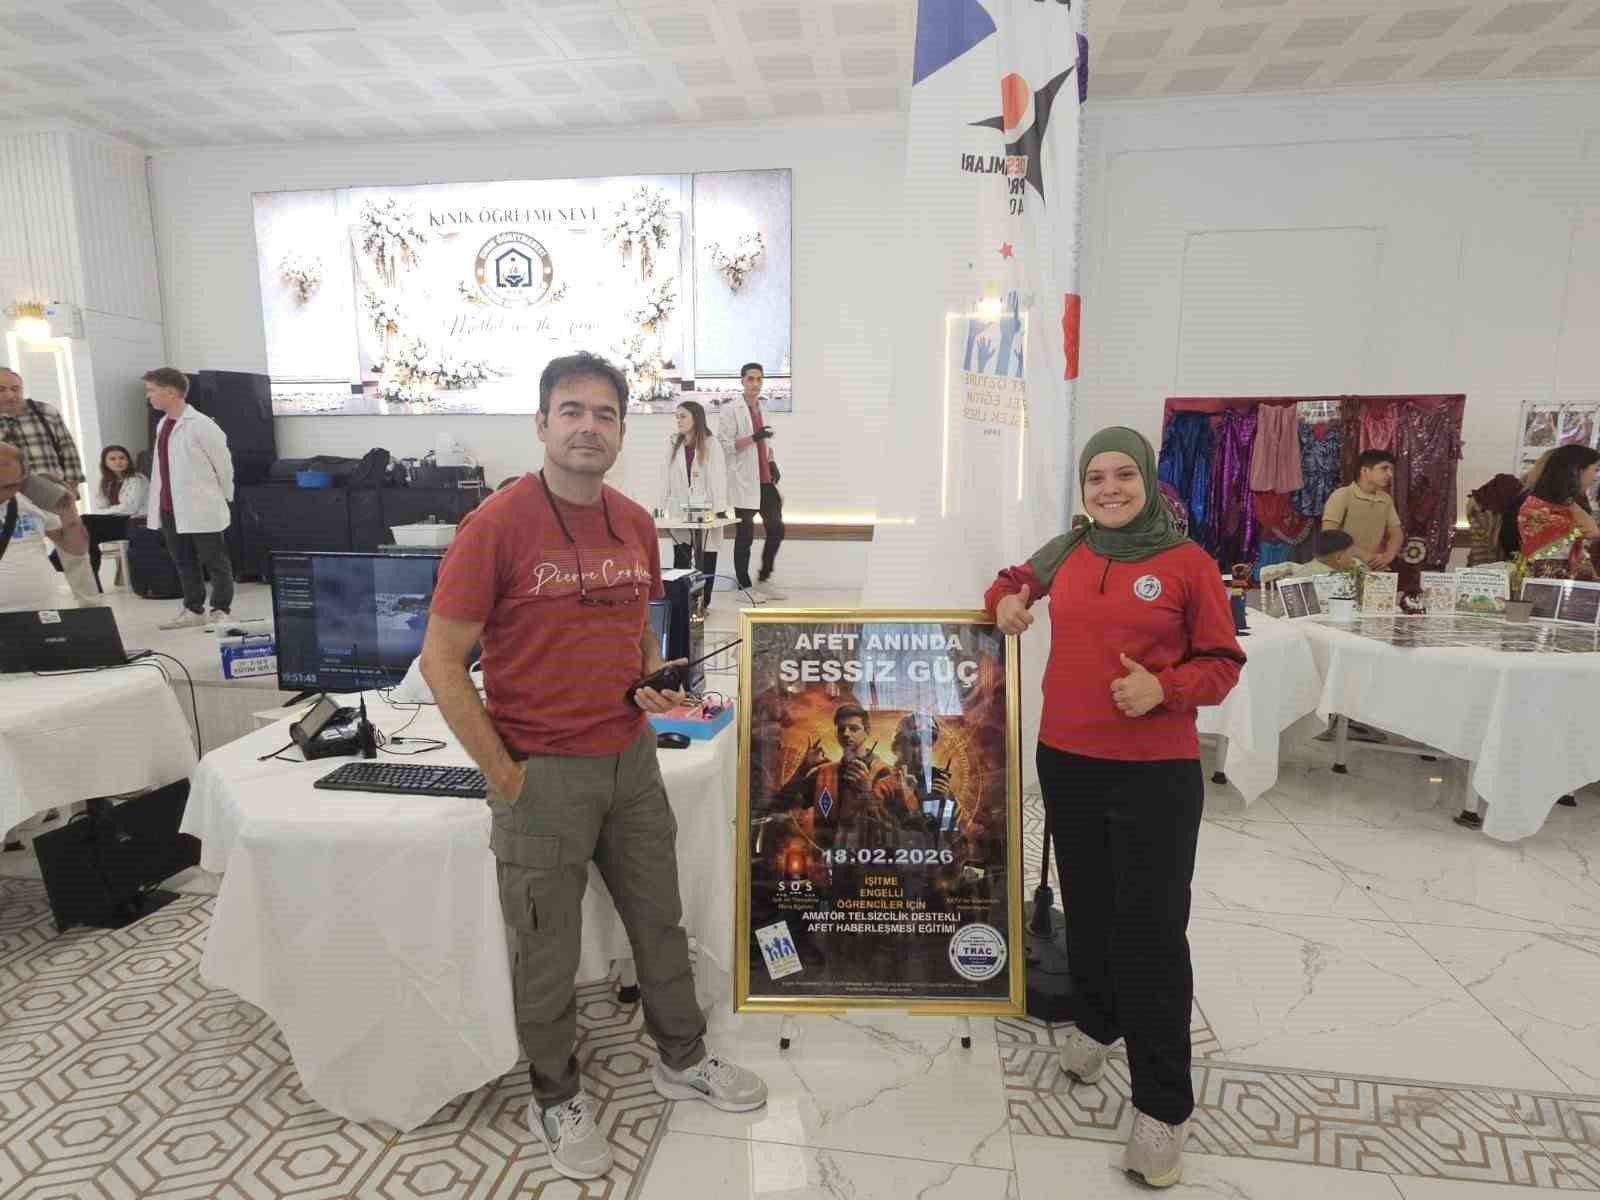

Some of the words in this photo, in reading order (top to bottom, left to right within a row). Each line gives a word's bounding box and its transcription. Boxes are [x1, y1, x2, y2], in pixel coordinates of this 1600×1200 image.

[793, 633, 859, 650] AFET
[865, 633, 963, 650] ANINDA
[779, 655, 897, 682] SESSİZ
[907, 655, 979, 688] GÜÇ
[822, 848, 954, 864] 18.02.2026
[864, 875, 898, 887] İŞİTME
[859, 887, 904, 898] ENGELLİ
[836, 898, 904, 909] ÖĞRENCİLER
[905, 898, 926, 911] İÇİN
[802, 910, 845, 921] AMATÖR
[849, 910, 909, 921] TELSİZCİLİK
[911, 911, 961, 922] DESTEKLİ
[807, 923, 833, 932] AFET
[836, 922, 915, 935] HABERLEŞMESİ
[918, 922, 956, 933] EĞİTİMİ
